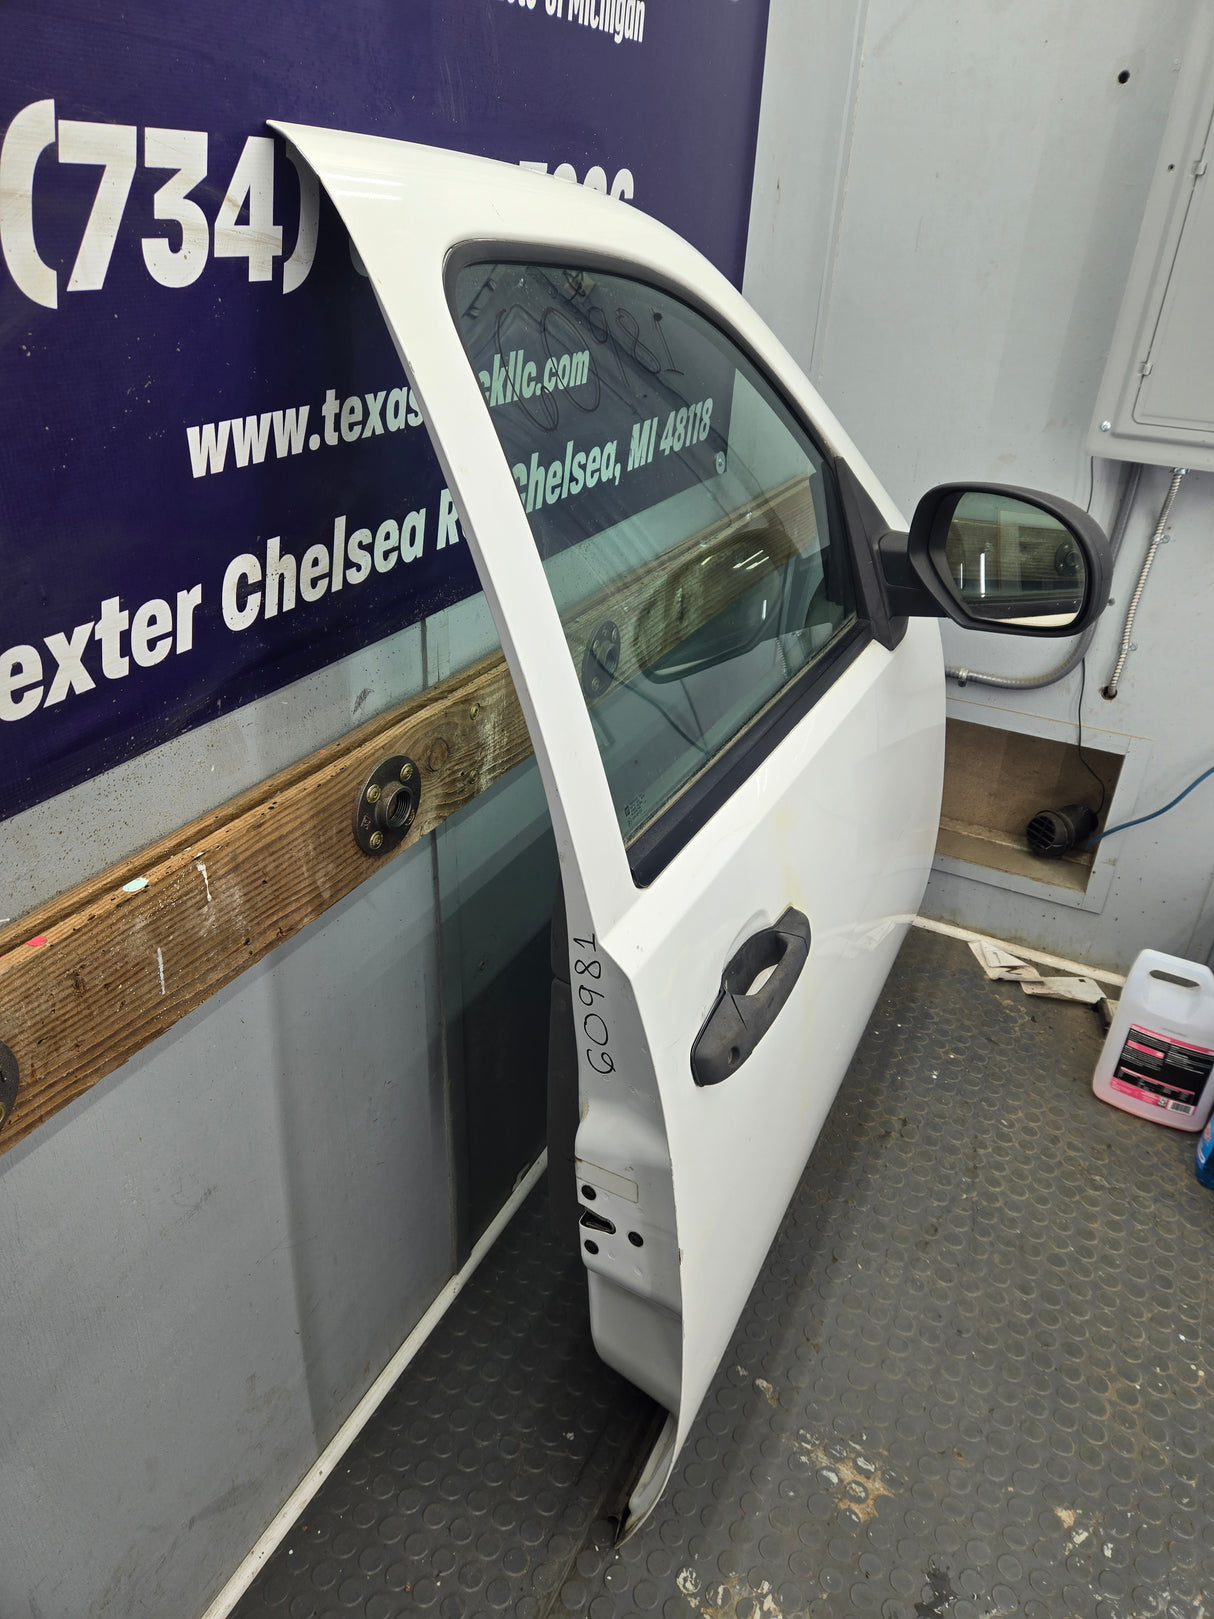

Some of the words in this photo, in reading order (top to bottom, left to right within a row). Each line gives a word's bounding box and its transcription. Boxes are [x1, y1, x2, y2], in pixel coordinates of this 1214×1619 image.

[0, 98, 320, 311] (734)
[496, 303, 685, 432] 60981
[0, 584, 202, 721] exter
[222, 508, 426, 631] Chelsea
[512, 440, 622, 514] Chelsea,
[627, 416, 658, 472] MI
[659, 398, 714, 456] 48118
[573, 933, 616, 1074] 60981
